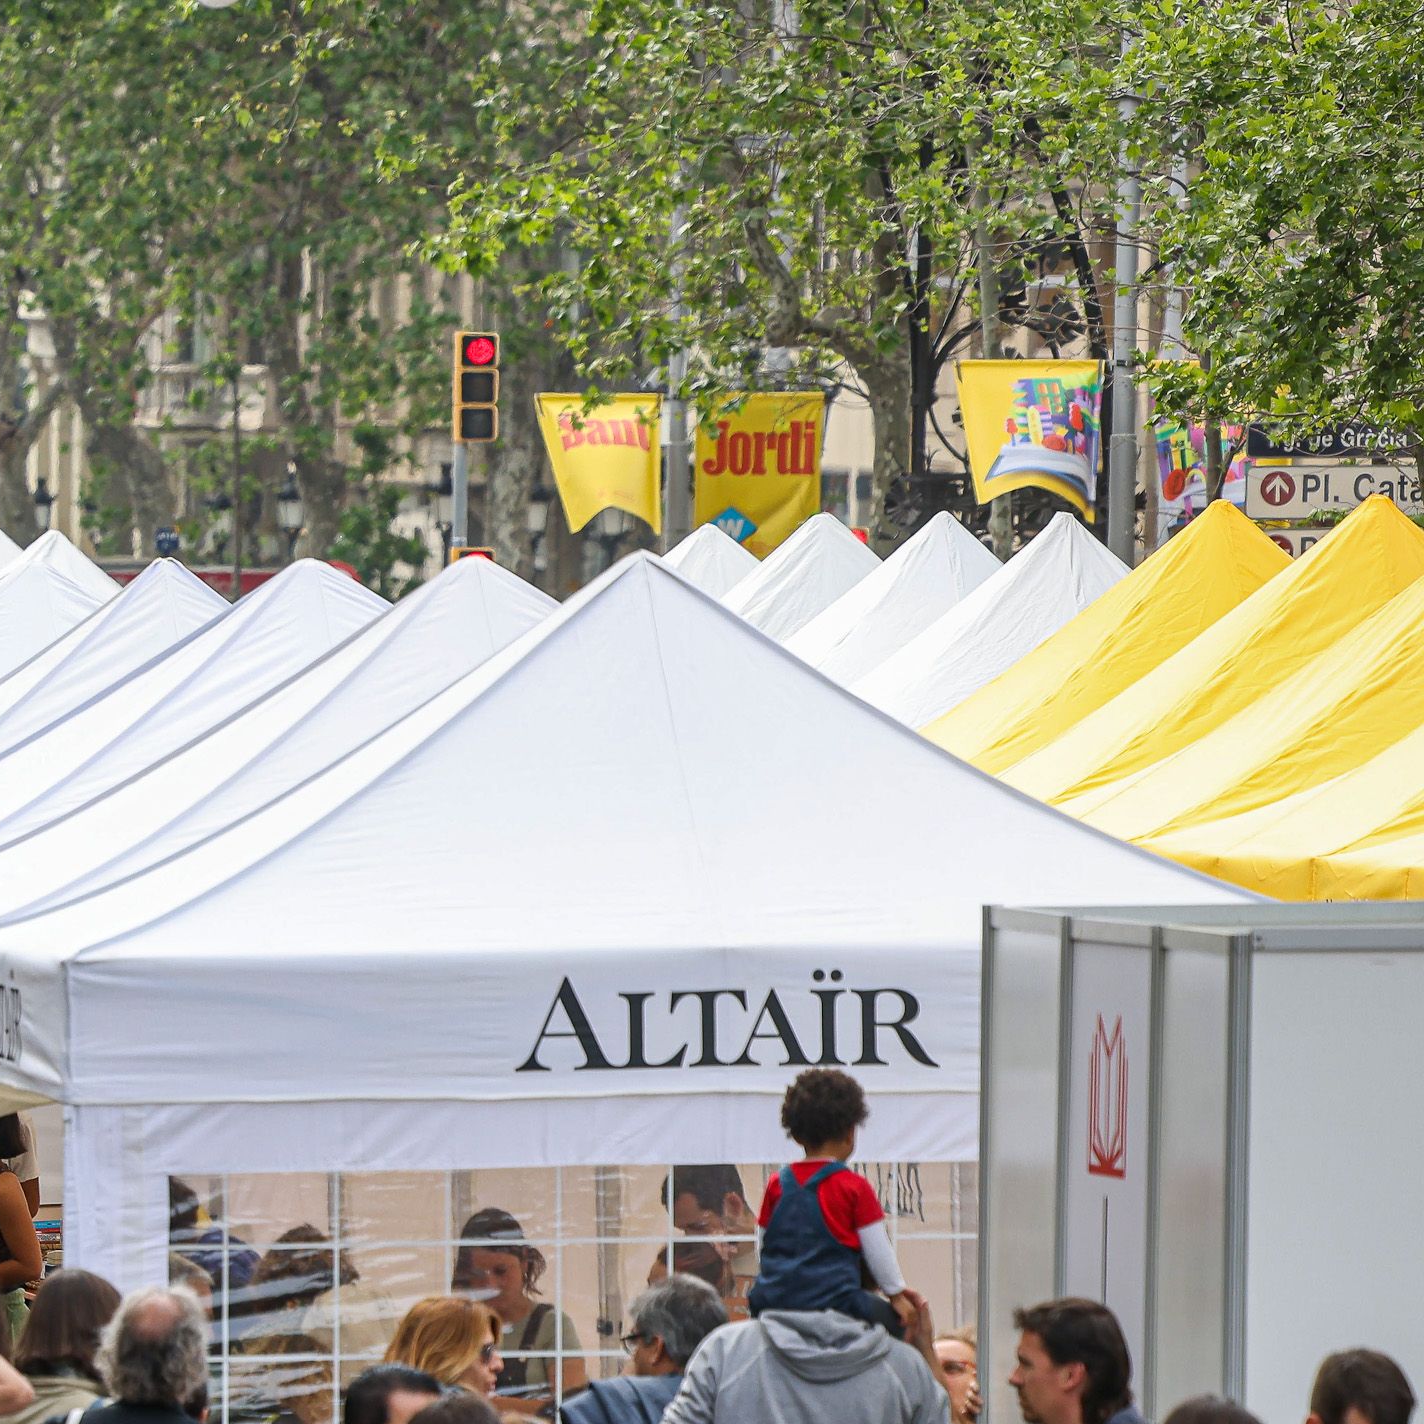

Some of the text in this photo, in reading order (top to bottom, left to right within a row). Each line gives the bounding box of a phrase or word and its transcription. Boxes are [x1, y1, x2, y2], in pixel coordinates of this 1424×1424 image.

[558, 411, 816, 476] Sant Jordi
[1303, 474, 1339, 502] Pl.
[515, 968, 941, 1071] ALTAÏR
